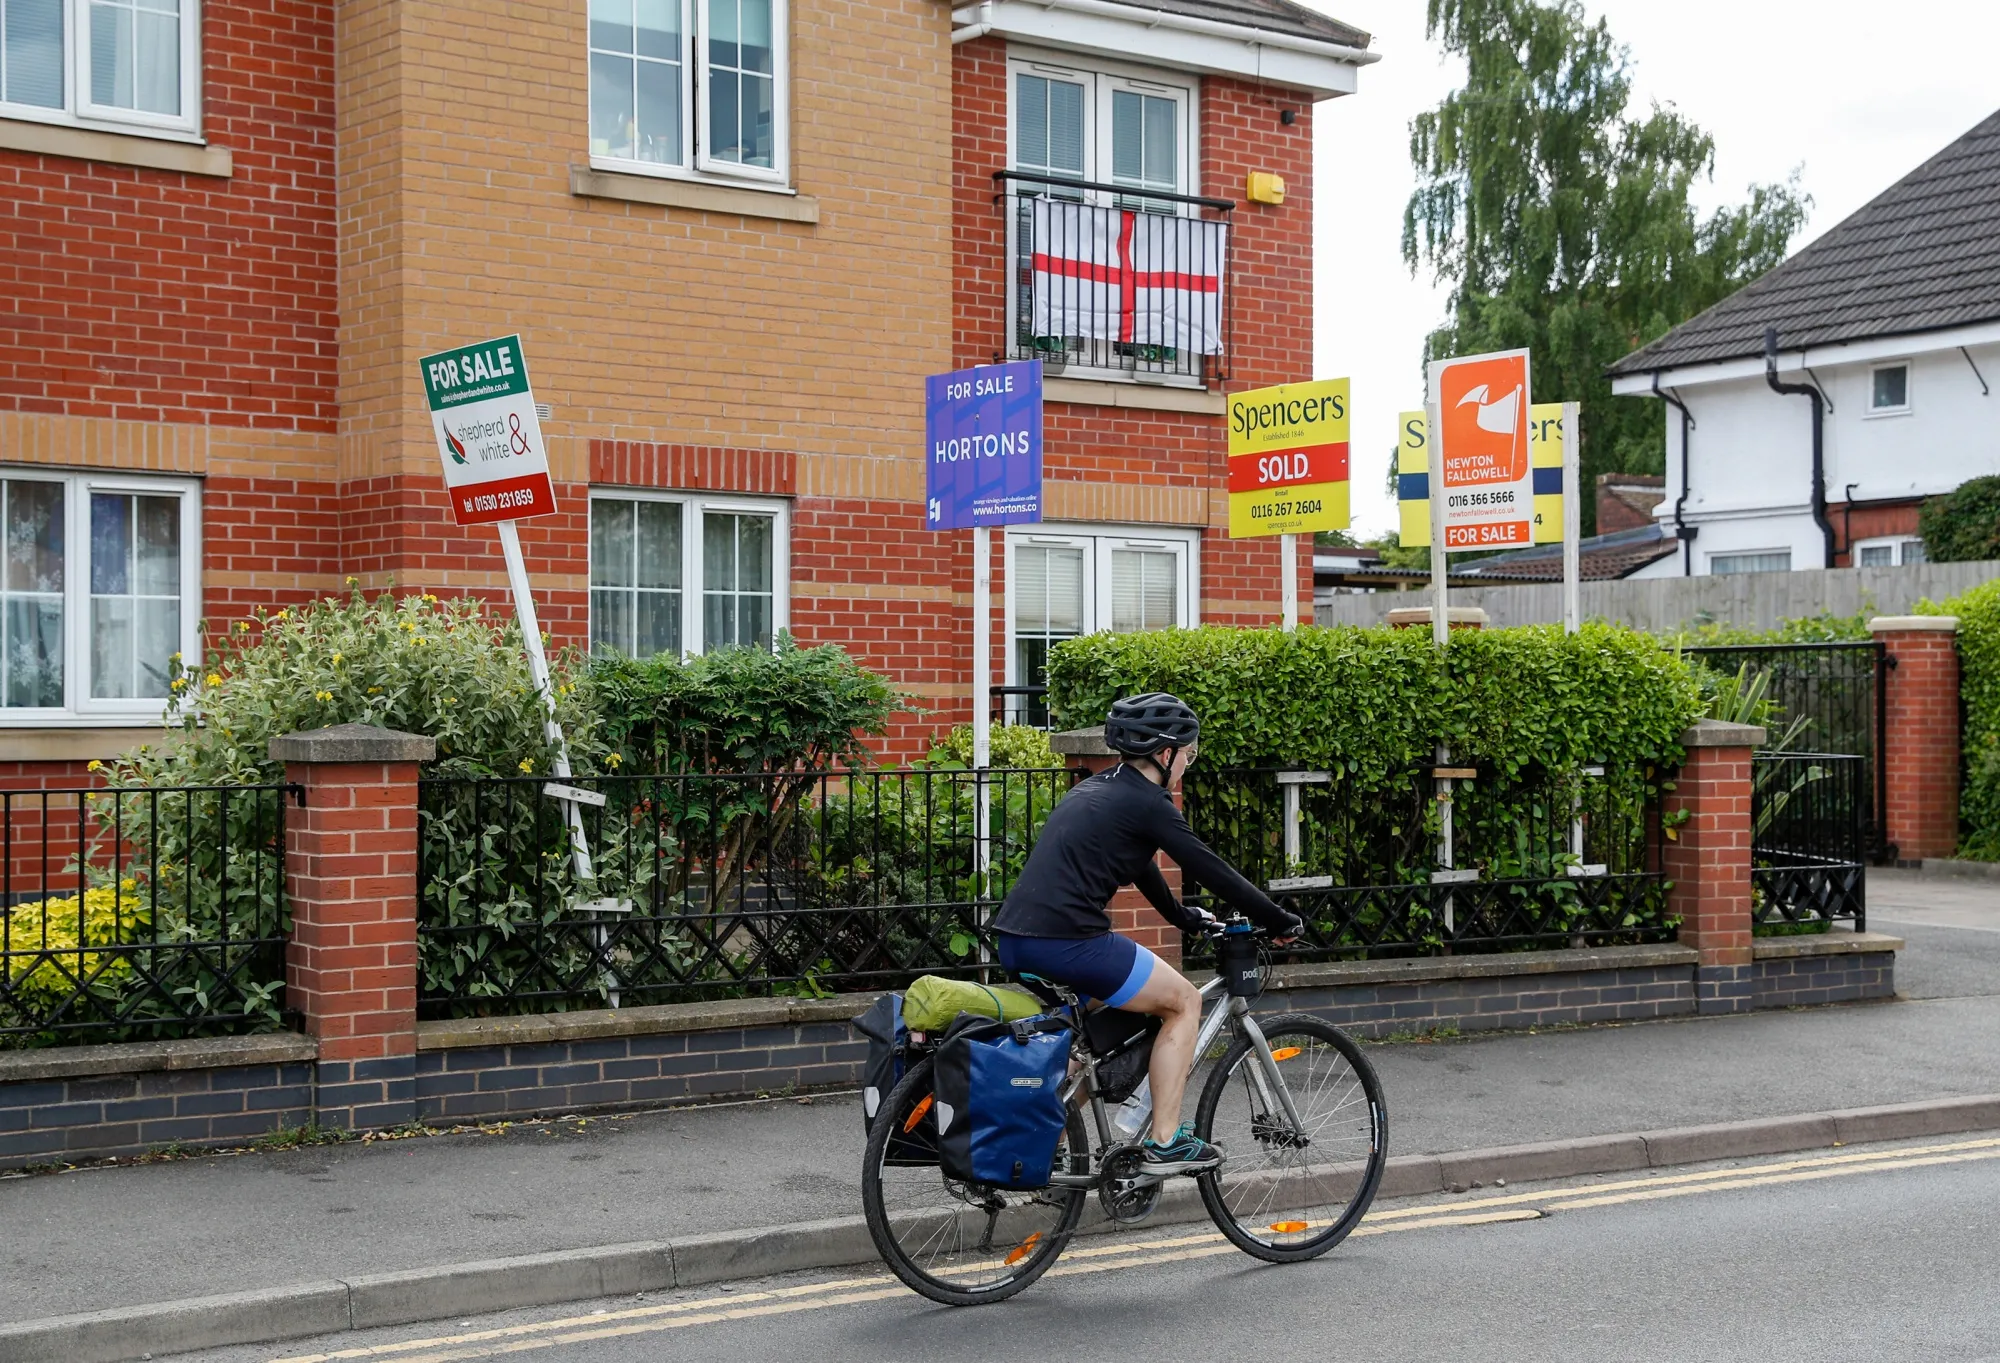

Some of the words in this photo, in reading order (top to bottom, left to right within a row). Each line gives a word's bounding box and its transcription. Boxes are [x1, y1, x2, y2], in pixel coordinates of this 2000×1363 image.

[429, 358, 461, 391] FOR
[462, 346, 514, 384] SALE
[947, 381, 971, 401] FOR
[976, 376, 1014, 396] SALE
[1233, 394, 1344, 440] Spencers
[458, 416, 504, 443] shepherd
[508, 413, 531, 455] &
[1263, 431, 1290, 441] Established
[1291, 430, 1305, 438] 1846
[479, 441, 510, 462] white
[936, 430, 1030, 464] HORTONS
[1446, 455, 1494, 469] NEWTON
[1446, 466, 1510, 482] FALLOWELL
[463, 498, 474, 513] tel
[474, 494, 498, 512] 01530
[499, 488, 534, 509] 231859
[1448, 494, 1468, 507] 0116
[1470, 493, 1488, 506] 366
[1490, 491, 1515, 504] 5666
[973, 503, 1037, 516] www.hortons.co
[1251, 504, 1272, 519] 0116
[1275, 502, 1293, 516] 267
[1295, 500, 1322, 514] 2604
[1448, 507, 1515, 518] newtonfallowell.co.uk
[1267, 519, 1302, 529] spencers.co.uk
[1449, 528, 1477, 544] FOR
[1481, 525, 1516, 542] SALE
